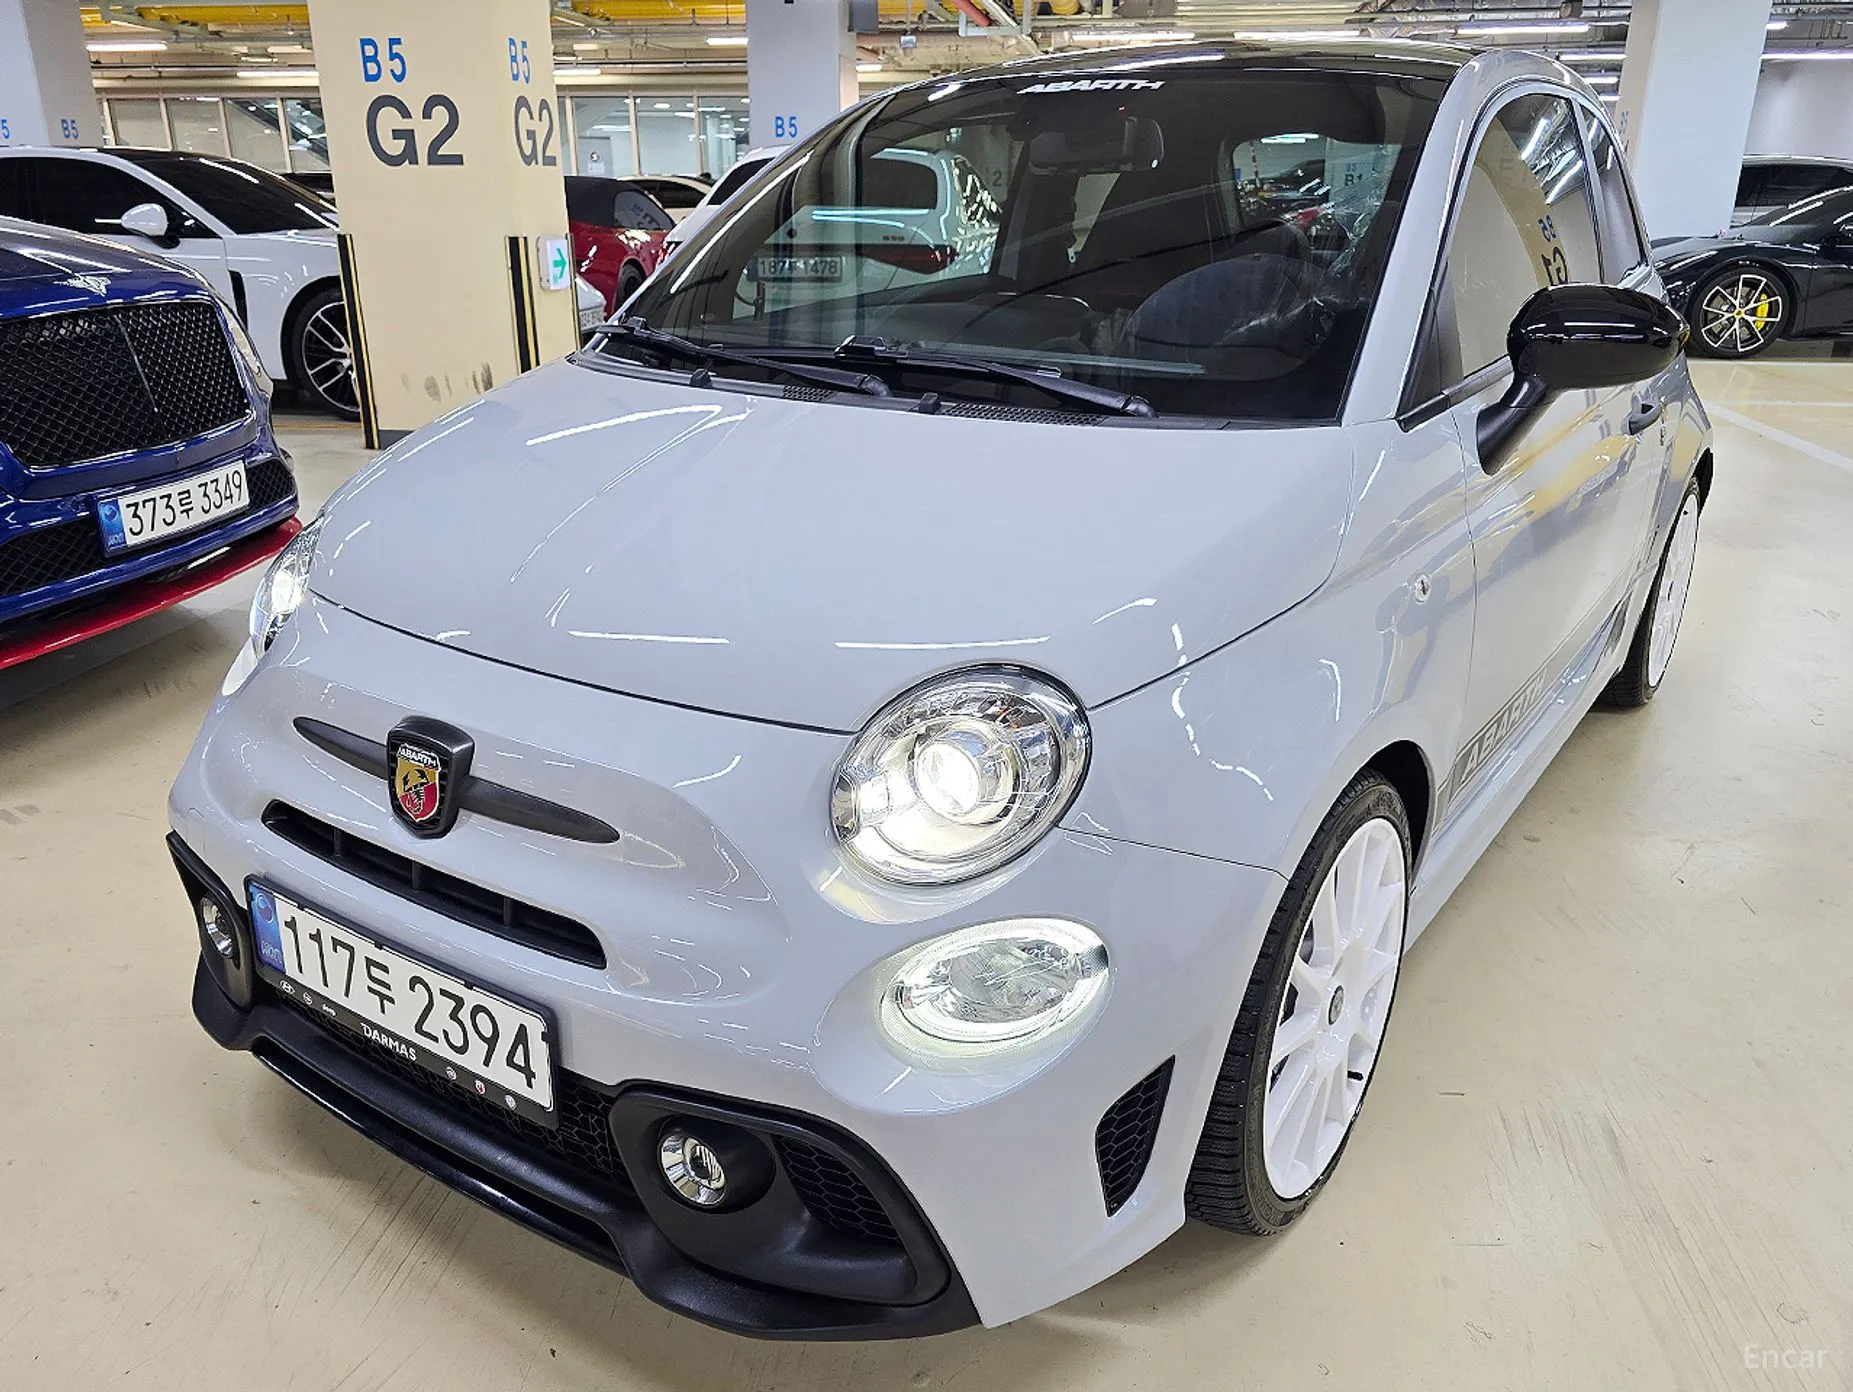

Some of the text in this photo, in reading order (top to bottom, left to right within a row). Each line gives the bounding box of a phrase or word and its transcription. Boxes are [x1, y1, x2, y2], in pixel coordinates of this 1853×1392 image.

[358, 37, 407, 83] B5
[508, 37, 531, 84] B5
[1016, 79, 1166, 95] ABARTH
[60, 119, 79, 139] B5
[366, 94, 464, 167] G2
[514, 95, 557, 167] G2
[774, 115, 799, 139] B5
[803, 259, 838, 275] 1478
[125, 469, 242, 536] 373루 3349
[399, 748, 437, 768] ABARTH
[284, 915, 536, 1089] 117두 2394
[360, 1022, 418, 1061] DARMAS
